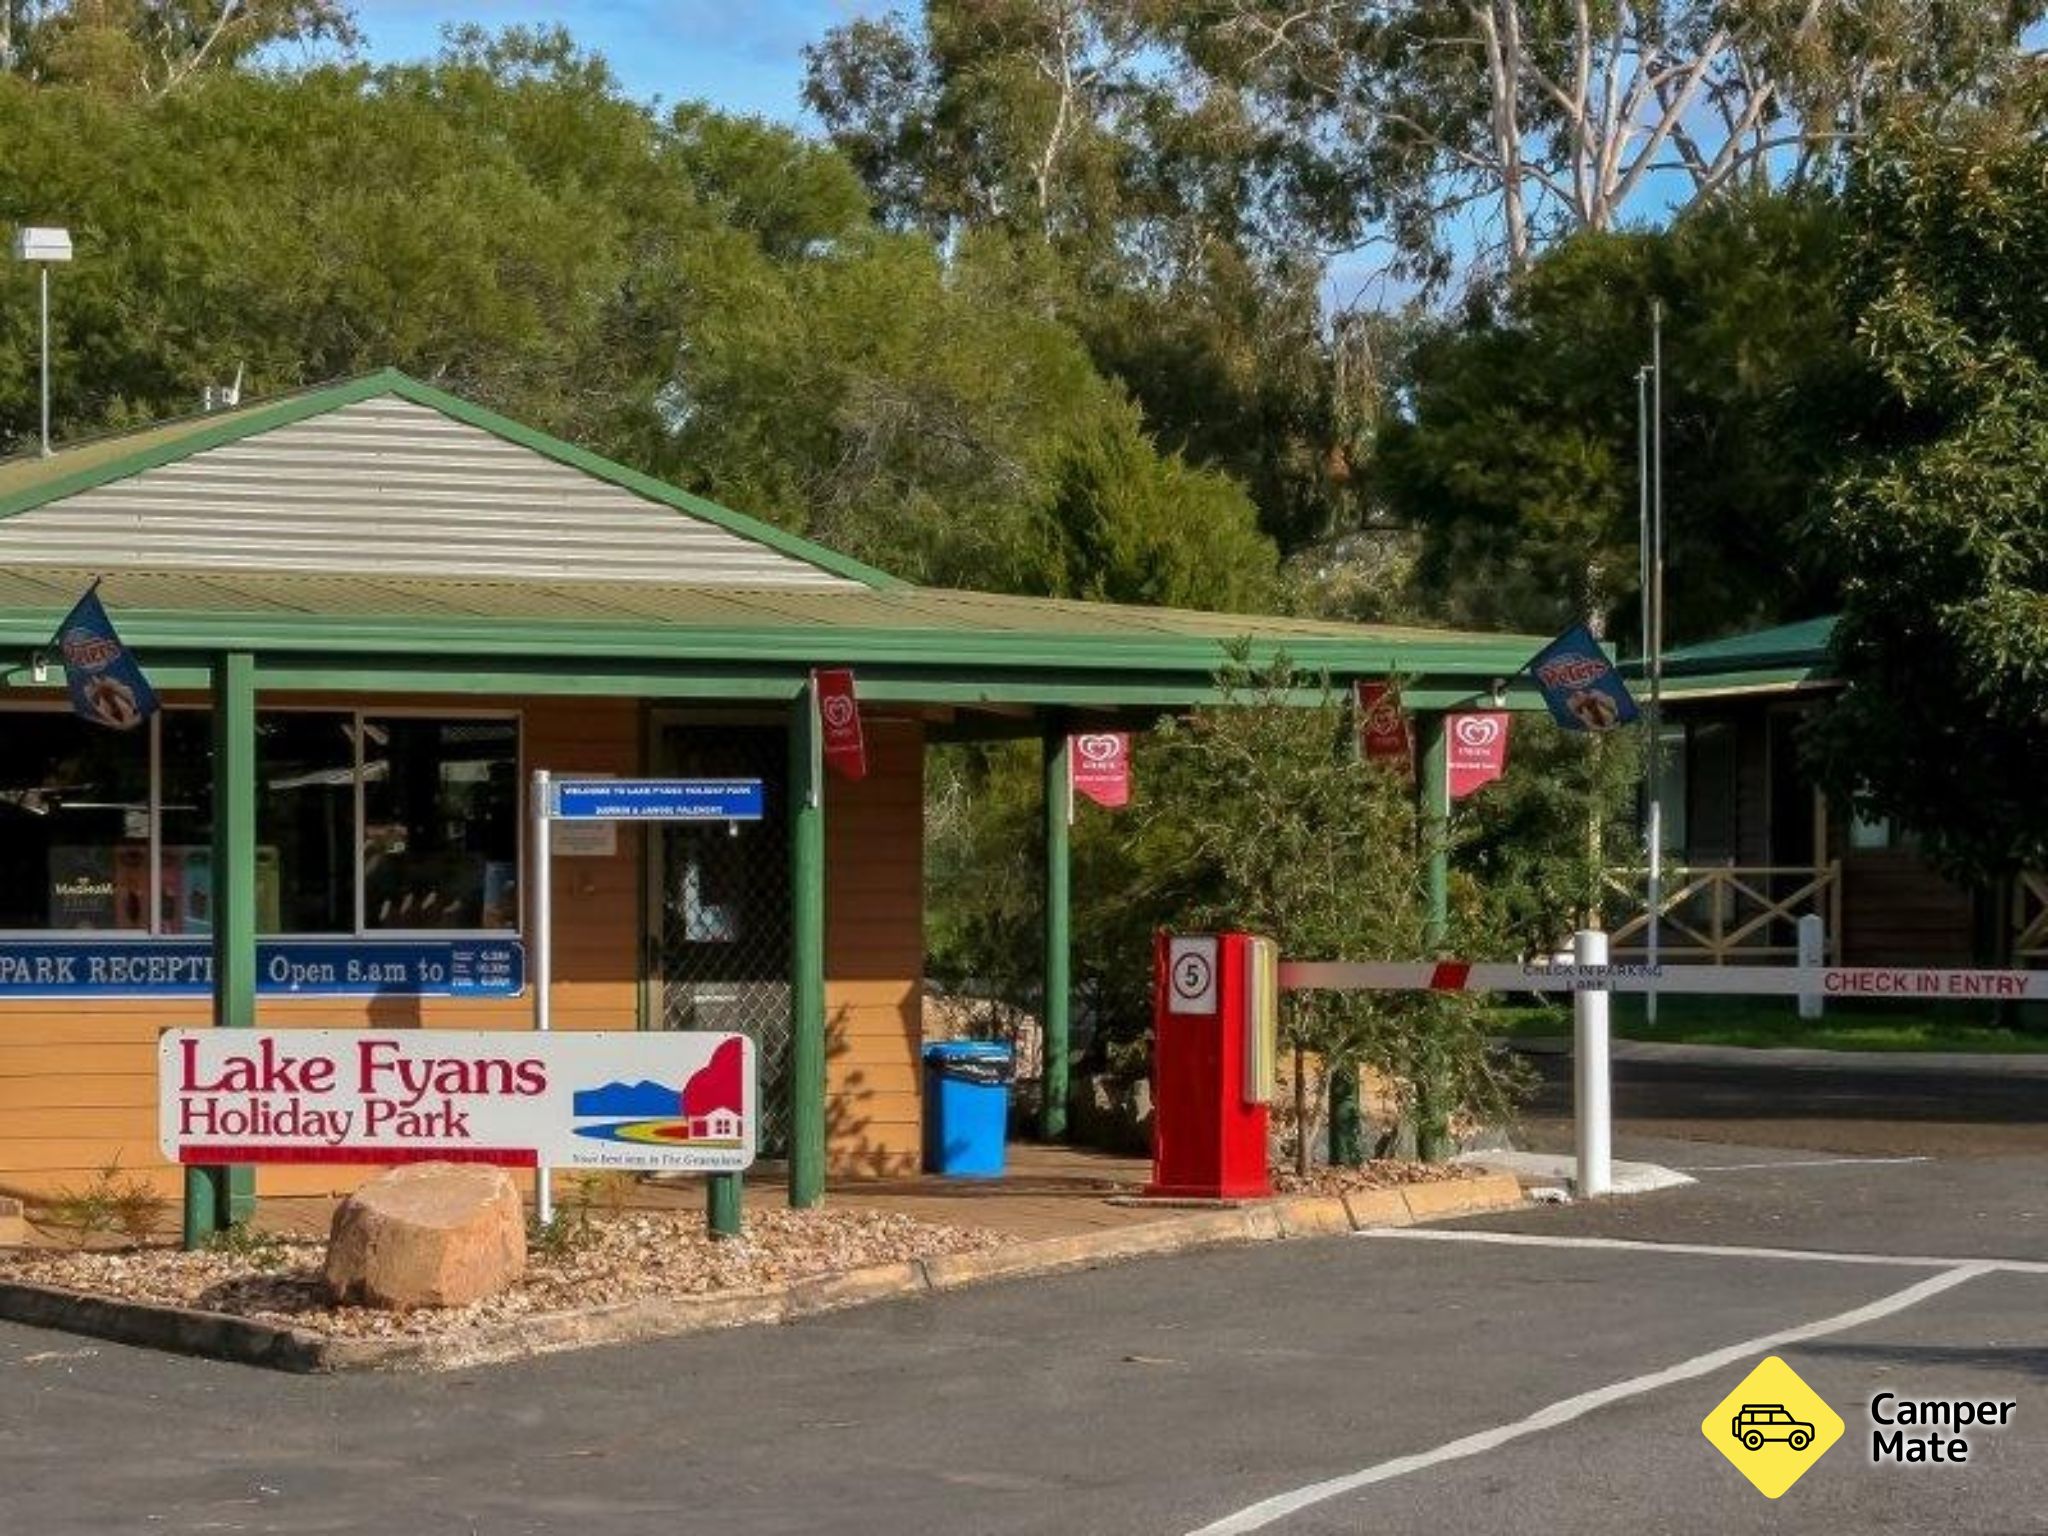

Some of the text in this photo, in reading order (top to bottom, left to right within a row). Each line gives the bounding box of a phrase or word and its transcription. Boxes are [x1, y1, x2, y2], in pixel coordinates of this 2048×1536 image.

[0, 956, 76, 984] PARK
[88, 956, 214, 984] RECEPTI
[268, 956, 336, 988] Open
[417, 957, 445, 982] to
[1185, 964, 1199, 987] 5
[1596, 964, 1662, 977] PARKING
[1824, 972, 2028, 995] CHECK IN ENTRY
[179, 1037, 548, 1107] Lake Fyans
[179, 1097, 471, 1145] Holiday Park
